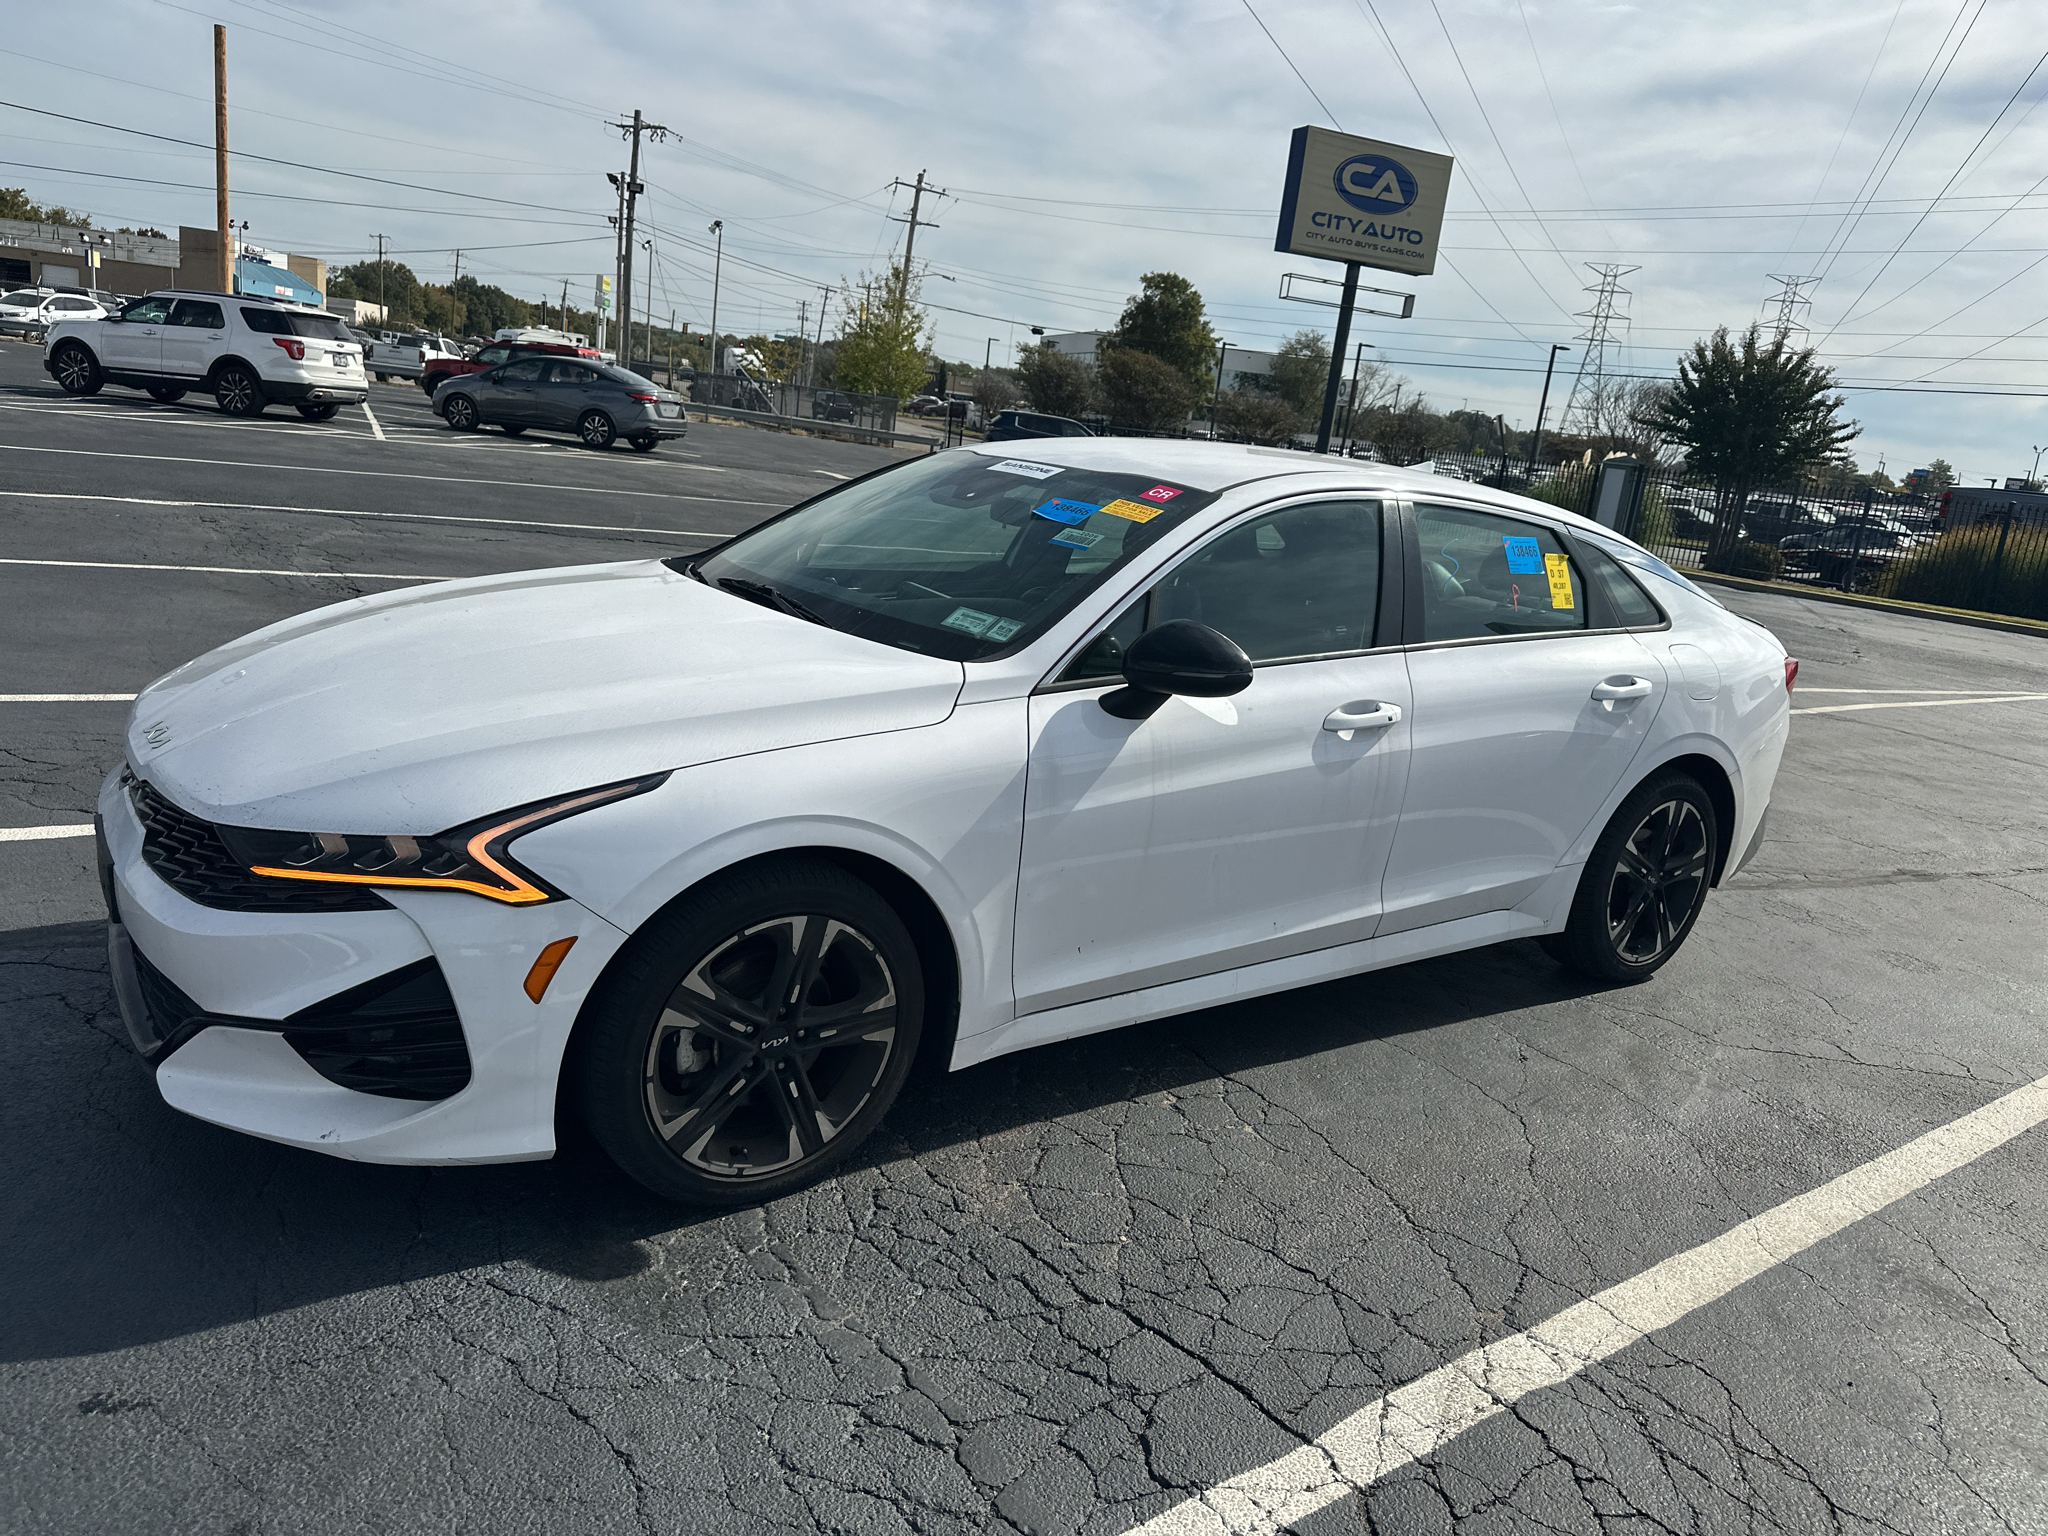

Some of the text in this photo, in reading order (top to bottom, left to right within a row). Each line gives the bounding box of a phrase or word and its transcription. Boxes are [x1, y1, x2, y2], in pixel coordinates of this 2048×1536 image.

[1341, 162, 1406, 205] CA
[1306, 231, 1425, 259] CITY AUTO BUYS CARS.COM
[1148, 488, 1174, 499] CR
[1511, 545, 1538, 557] 138466
